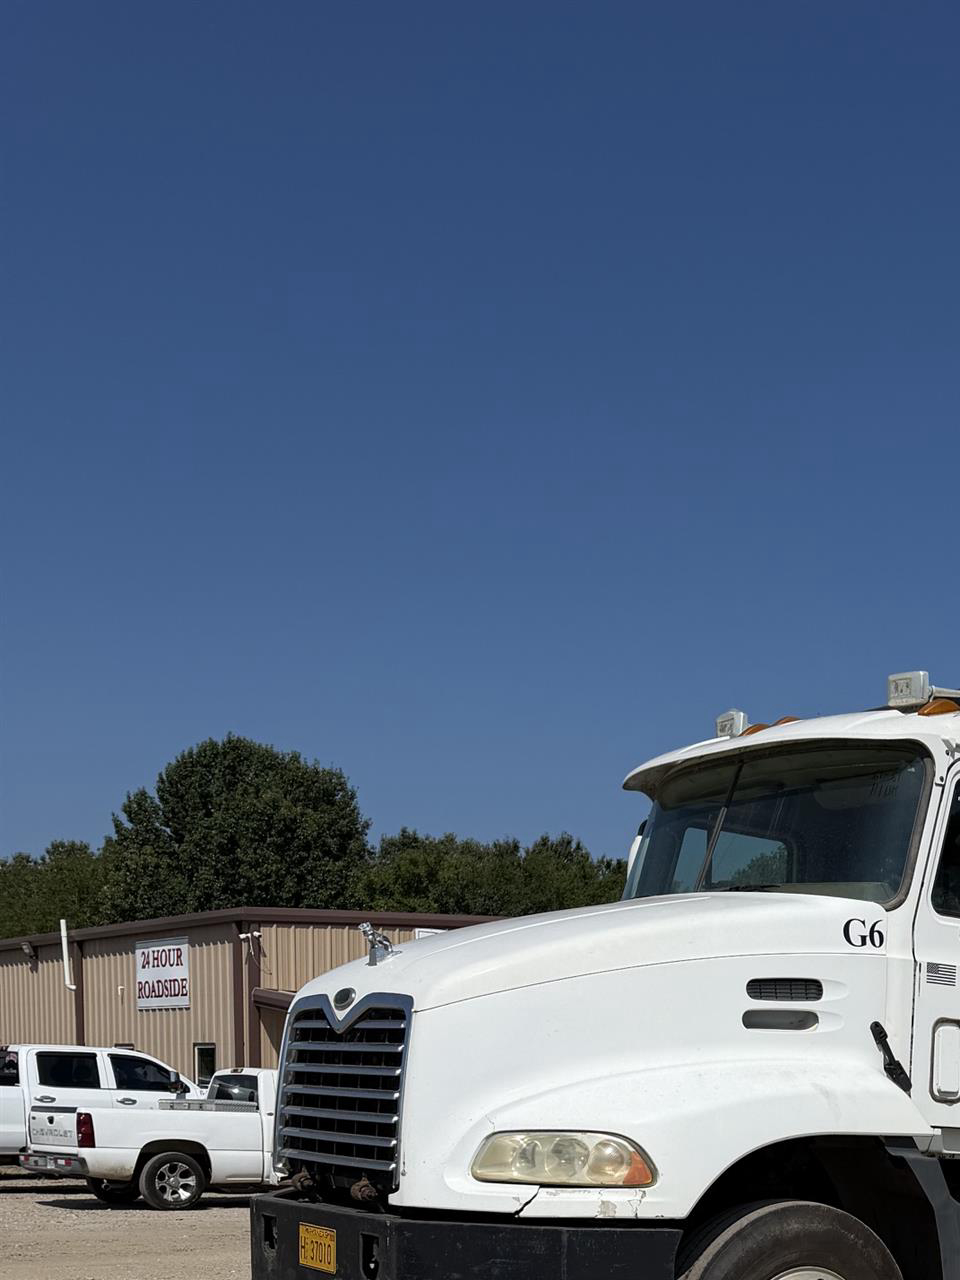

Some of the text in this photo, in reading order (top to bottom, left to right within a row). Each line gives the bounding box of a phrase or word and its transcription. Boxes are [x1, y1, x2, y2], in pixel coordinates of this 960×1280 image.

[843, 918, 885, 948] G6
[141, 948, 183, 970] 24 HOUR
[137, 978, 188, 999] ROADSIDE
[32, 1128, 73, 1138] CHEVROLET
[310, 1239, 332, 1265] 37010
